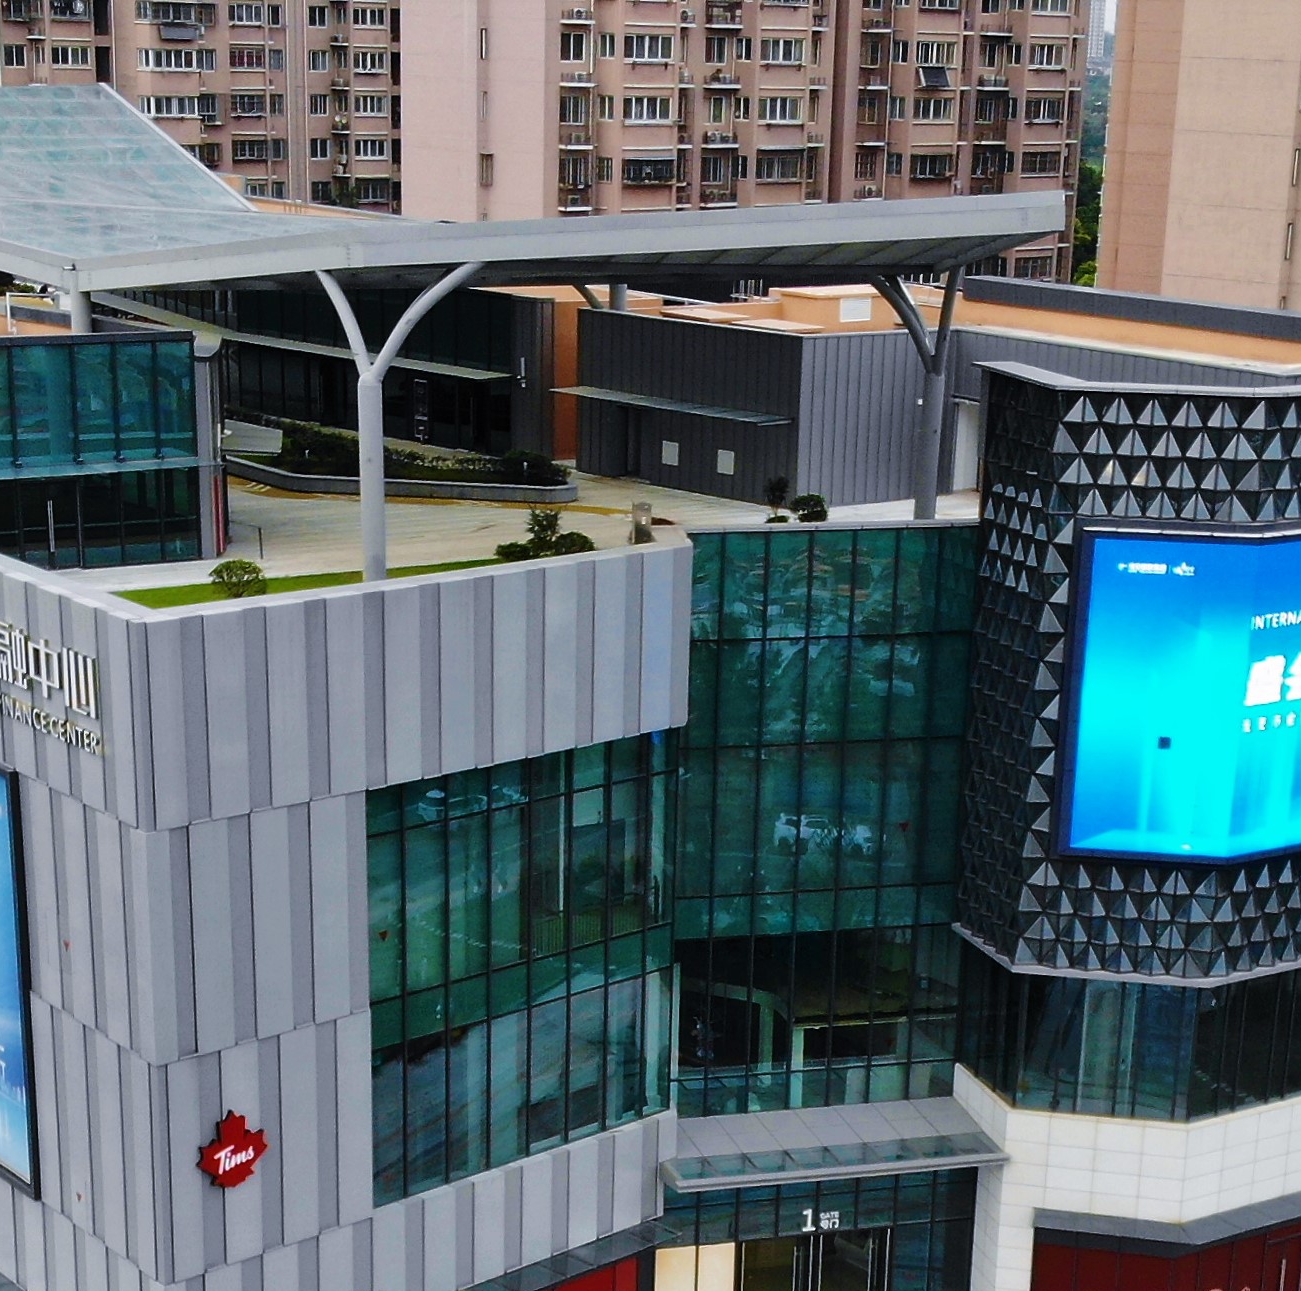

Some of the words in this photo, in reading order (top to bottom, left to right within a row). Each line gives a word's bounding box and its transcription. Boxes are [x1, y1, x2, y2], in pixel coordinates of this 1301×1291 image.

[49, 716, 100, 756] CENTER
[213, 1144, 255, 1175] Tims
[802, 1208, 816, 1232] 1
[820, 1211, 840, 1220] GATE
